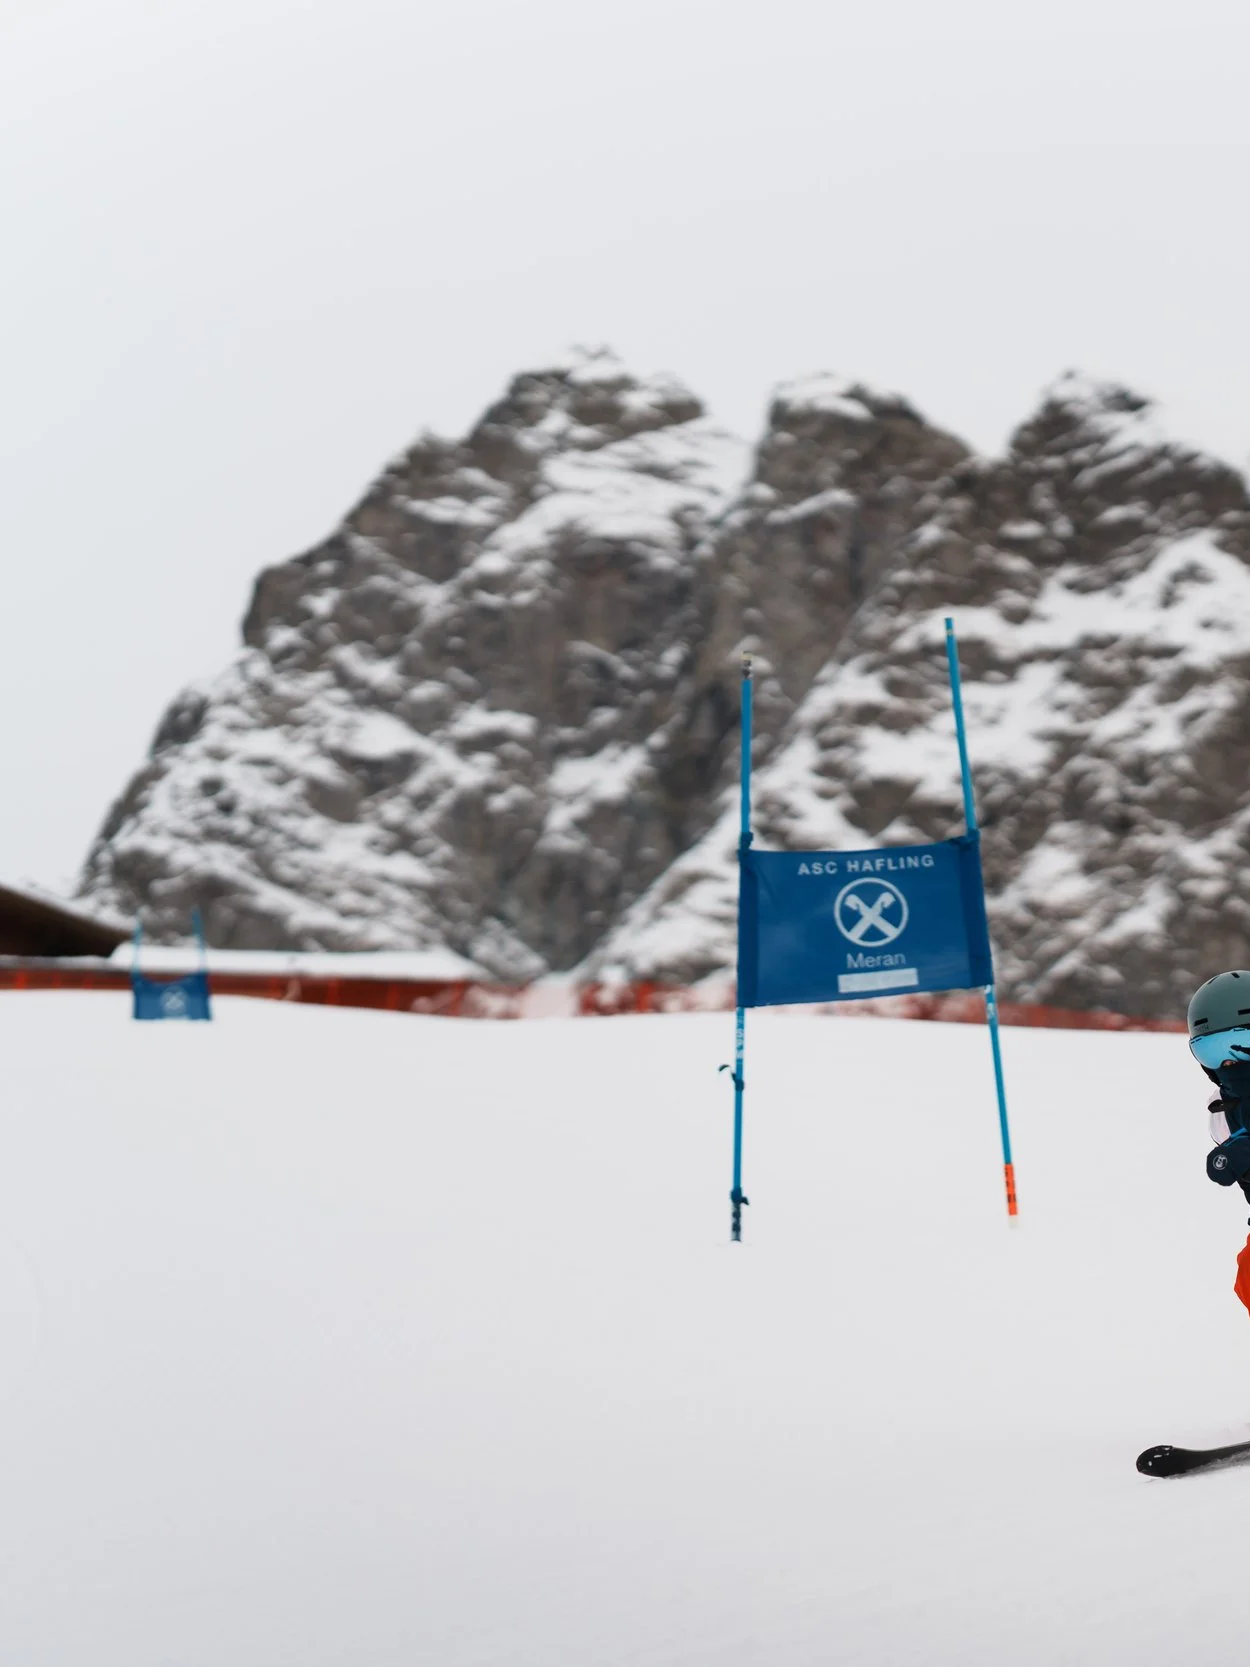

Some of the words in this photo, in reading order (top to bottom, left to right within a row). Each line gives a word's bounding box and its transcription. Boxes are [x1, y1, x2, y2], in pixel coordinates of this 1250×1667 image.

[797, 861, 838, 876] ASC
[847, 854, 936, 873] HAFLING
[847, 952, 907, 969] Meran
